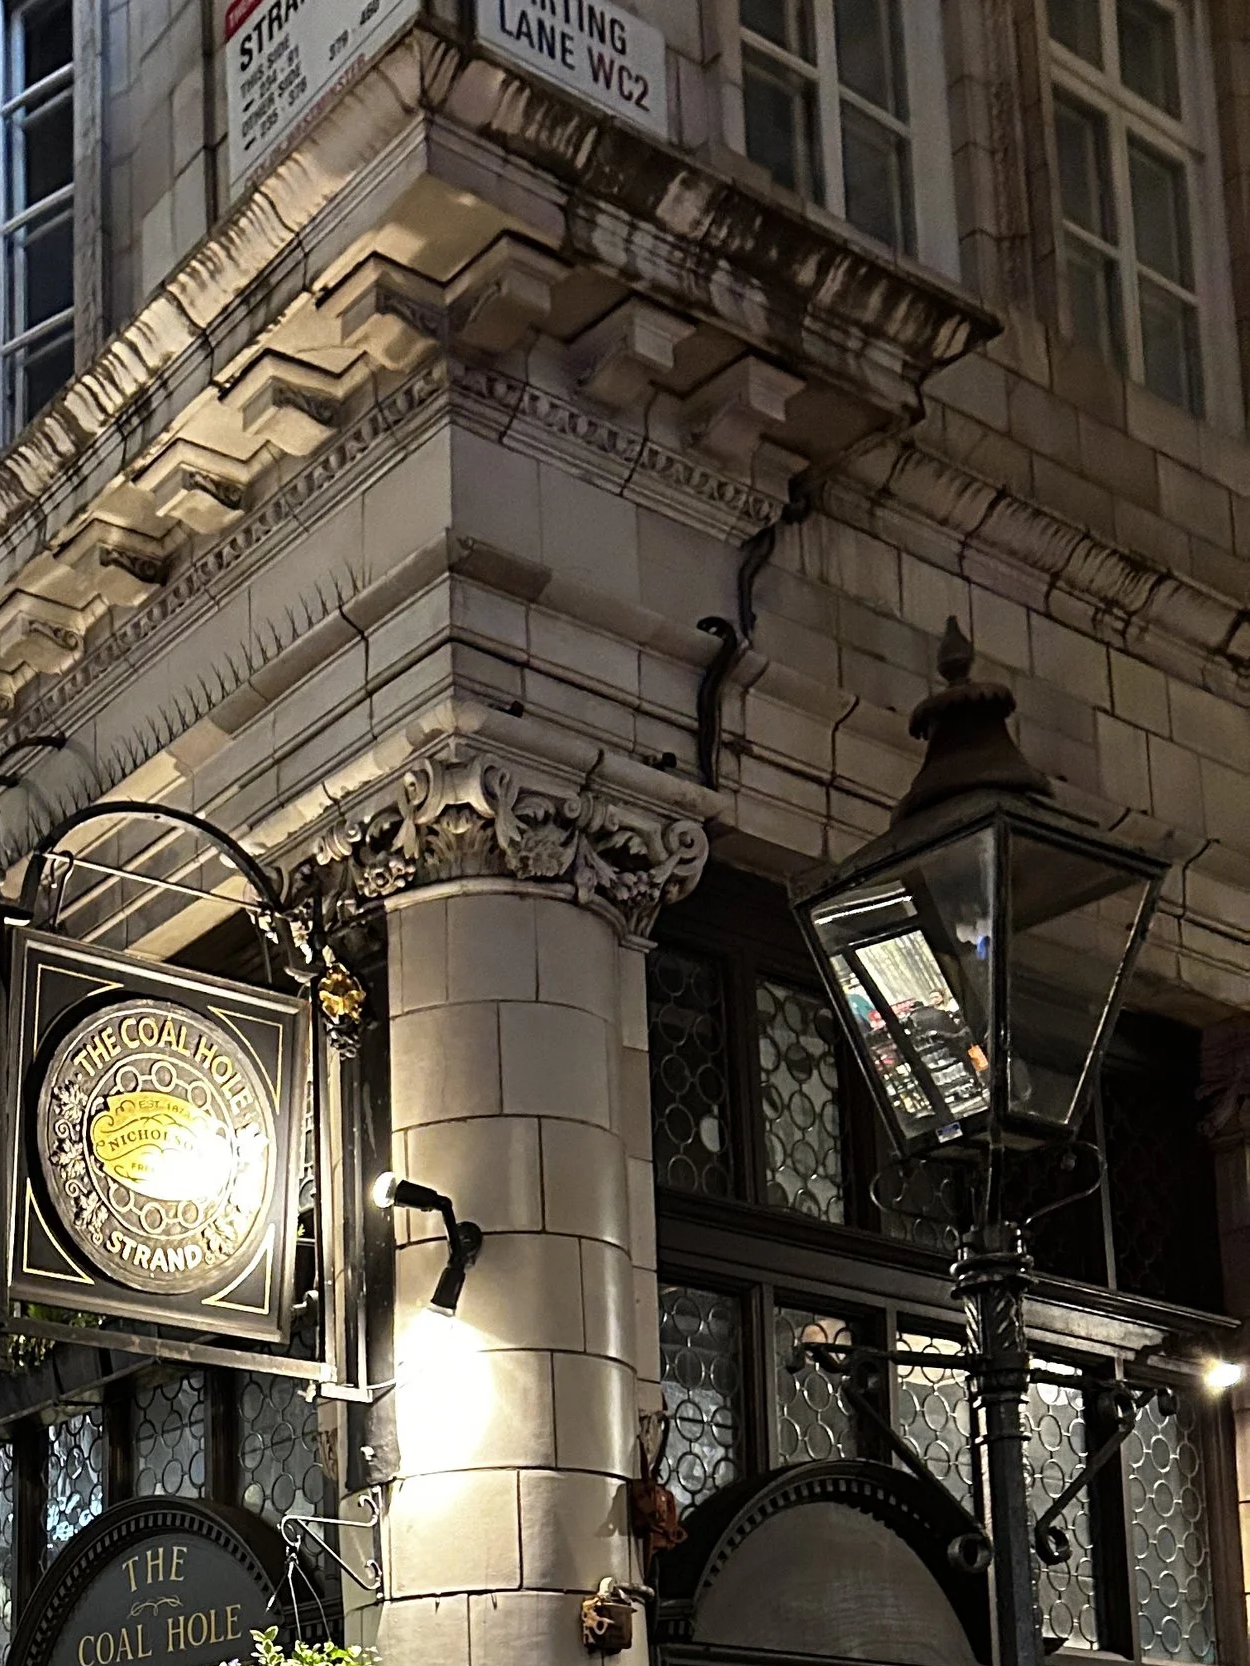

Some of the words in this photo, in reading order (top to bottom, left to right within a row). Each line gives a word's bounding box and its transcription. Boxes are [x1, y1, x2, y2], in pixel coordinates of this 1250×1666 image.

[240, 0, 304, 72] STRA
[500, 0, 575, 70] LANE
[588, 46, 650, 112] WC2
[532, 0, 627, 55] TING
[240, 63, 264, 98] THIS
[267, 32, 289, 69] SIDE
[72, 1025, 122, 1079] THE
[119, 1017, 191, 1054] COAL
[196, 1041, 254, 1114] HOLE
[105, 1231, 204, 1273] STRAND
[121, 1545, 188, 1593] THE
[166, 1603, 242, 1653] HOLE
